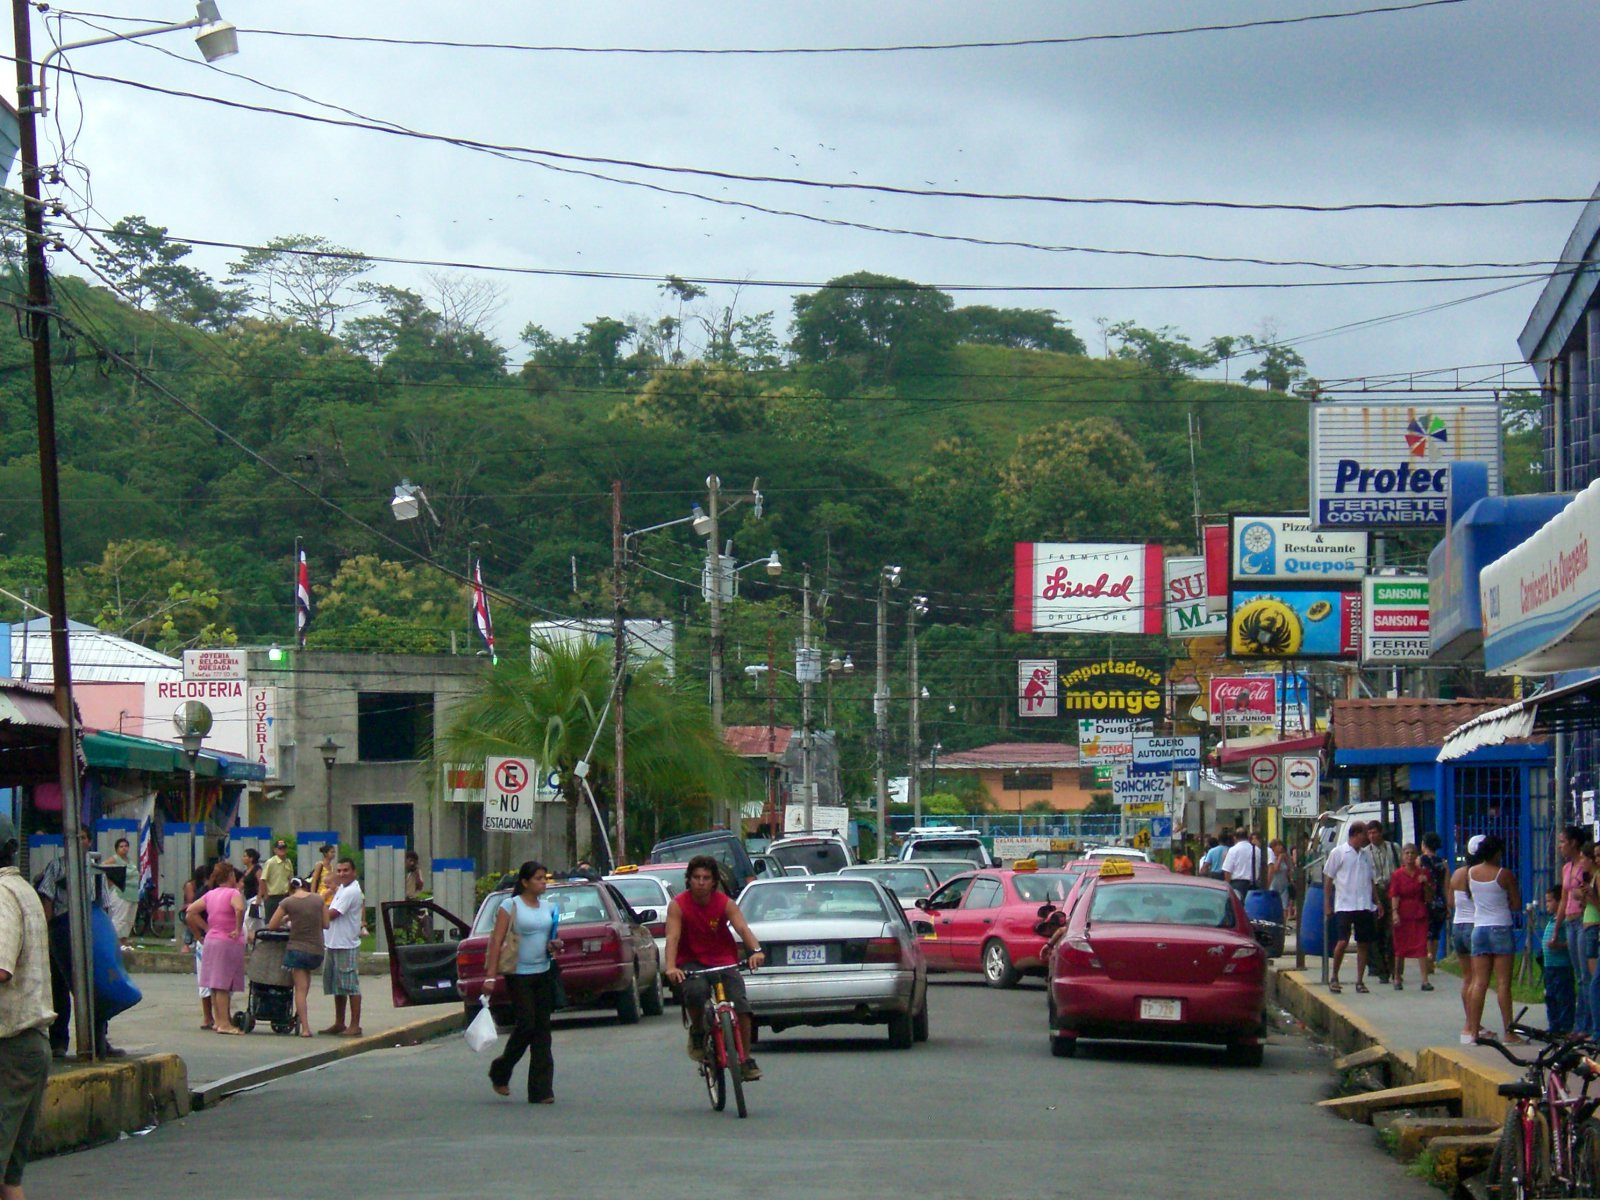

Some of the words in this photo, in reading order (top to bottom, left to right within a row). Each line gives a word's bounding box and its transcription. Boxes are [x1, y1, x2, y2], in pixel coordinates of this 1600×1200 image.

[1329, 500, 1447, 511] FERRETE
[1327, 511, 1438, 522] COSTANERA
[1315, 535, 1323, 543] &
[1285, 544, 1355, 553] Restaurante
[1042, 566, 1133, 602] Fischel
[1378, 589, 1421, 600] SANSON
[1048, 614, 1127, 622] DRUGSTORE
[1175, 604, 1227, 630] M
[1375, 616, 1418, 627] SANSON
[1344, 595, 1361, 653] Imperial
[1372, 640, 1429, 648] FERRE
[1059, 659, 1162, 688] importadora
[158, 682, 242, 698] RELOJERIA
[1066, 690, 1161, 715] monge
[256, 691, 268, 764] JOYERIA
[1149, 739, 1184, 747] CAJERO
[505, 766, 517, 787] E
[1114, 779, 1165, 793] SANCHEZ
[500, 795, 519, 812] NO
[486, 817, 533, 829] ESTACIONAR
